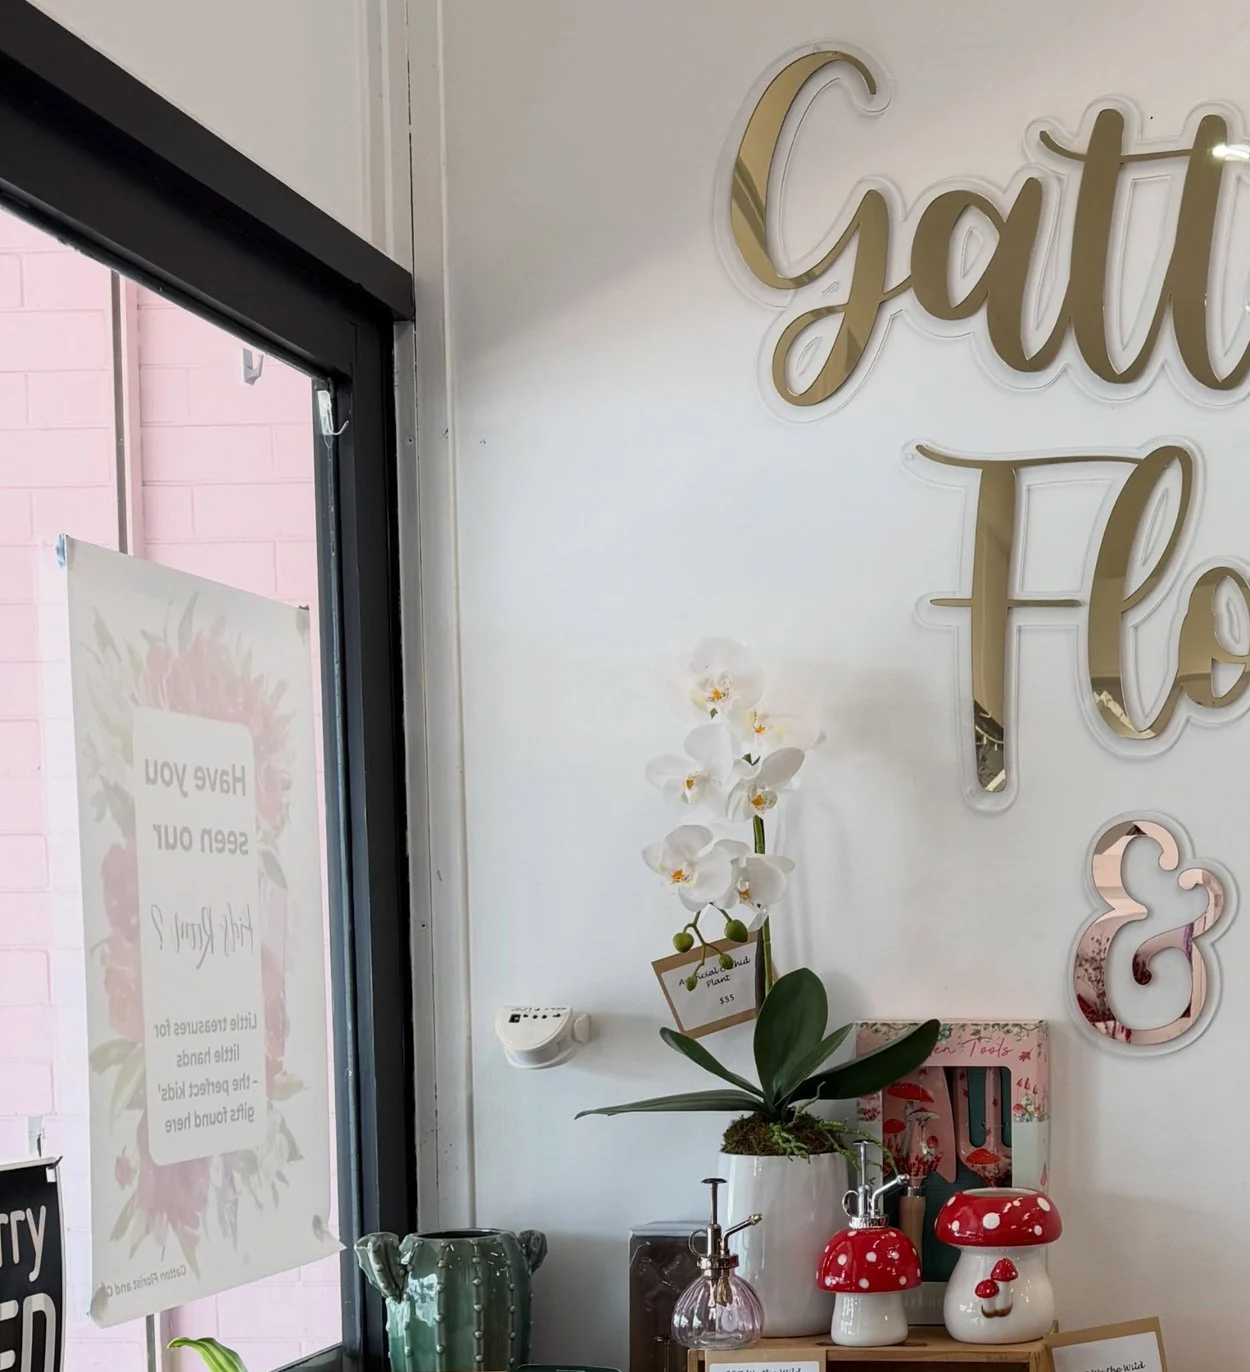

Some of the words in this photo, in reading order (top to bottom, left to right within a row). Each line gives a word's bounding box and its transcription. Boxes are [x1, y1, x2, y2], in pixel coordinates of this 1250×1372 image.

[1075, 820, 1226, 1044] &
[706, 974, 731, 988] Plant
[720, 994, 735, 1006] $55
[963, 1037, 1015, 1058] Tools
[1123, 1361, 1146, 1371] Wild
